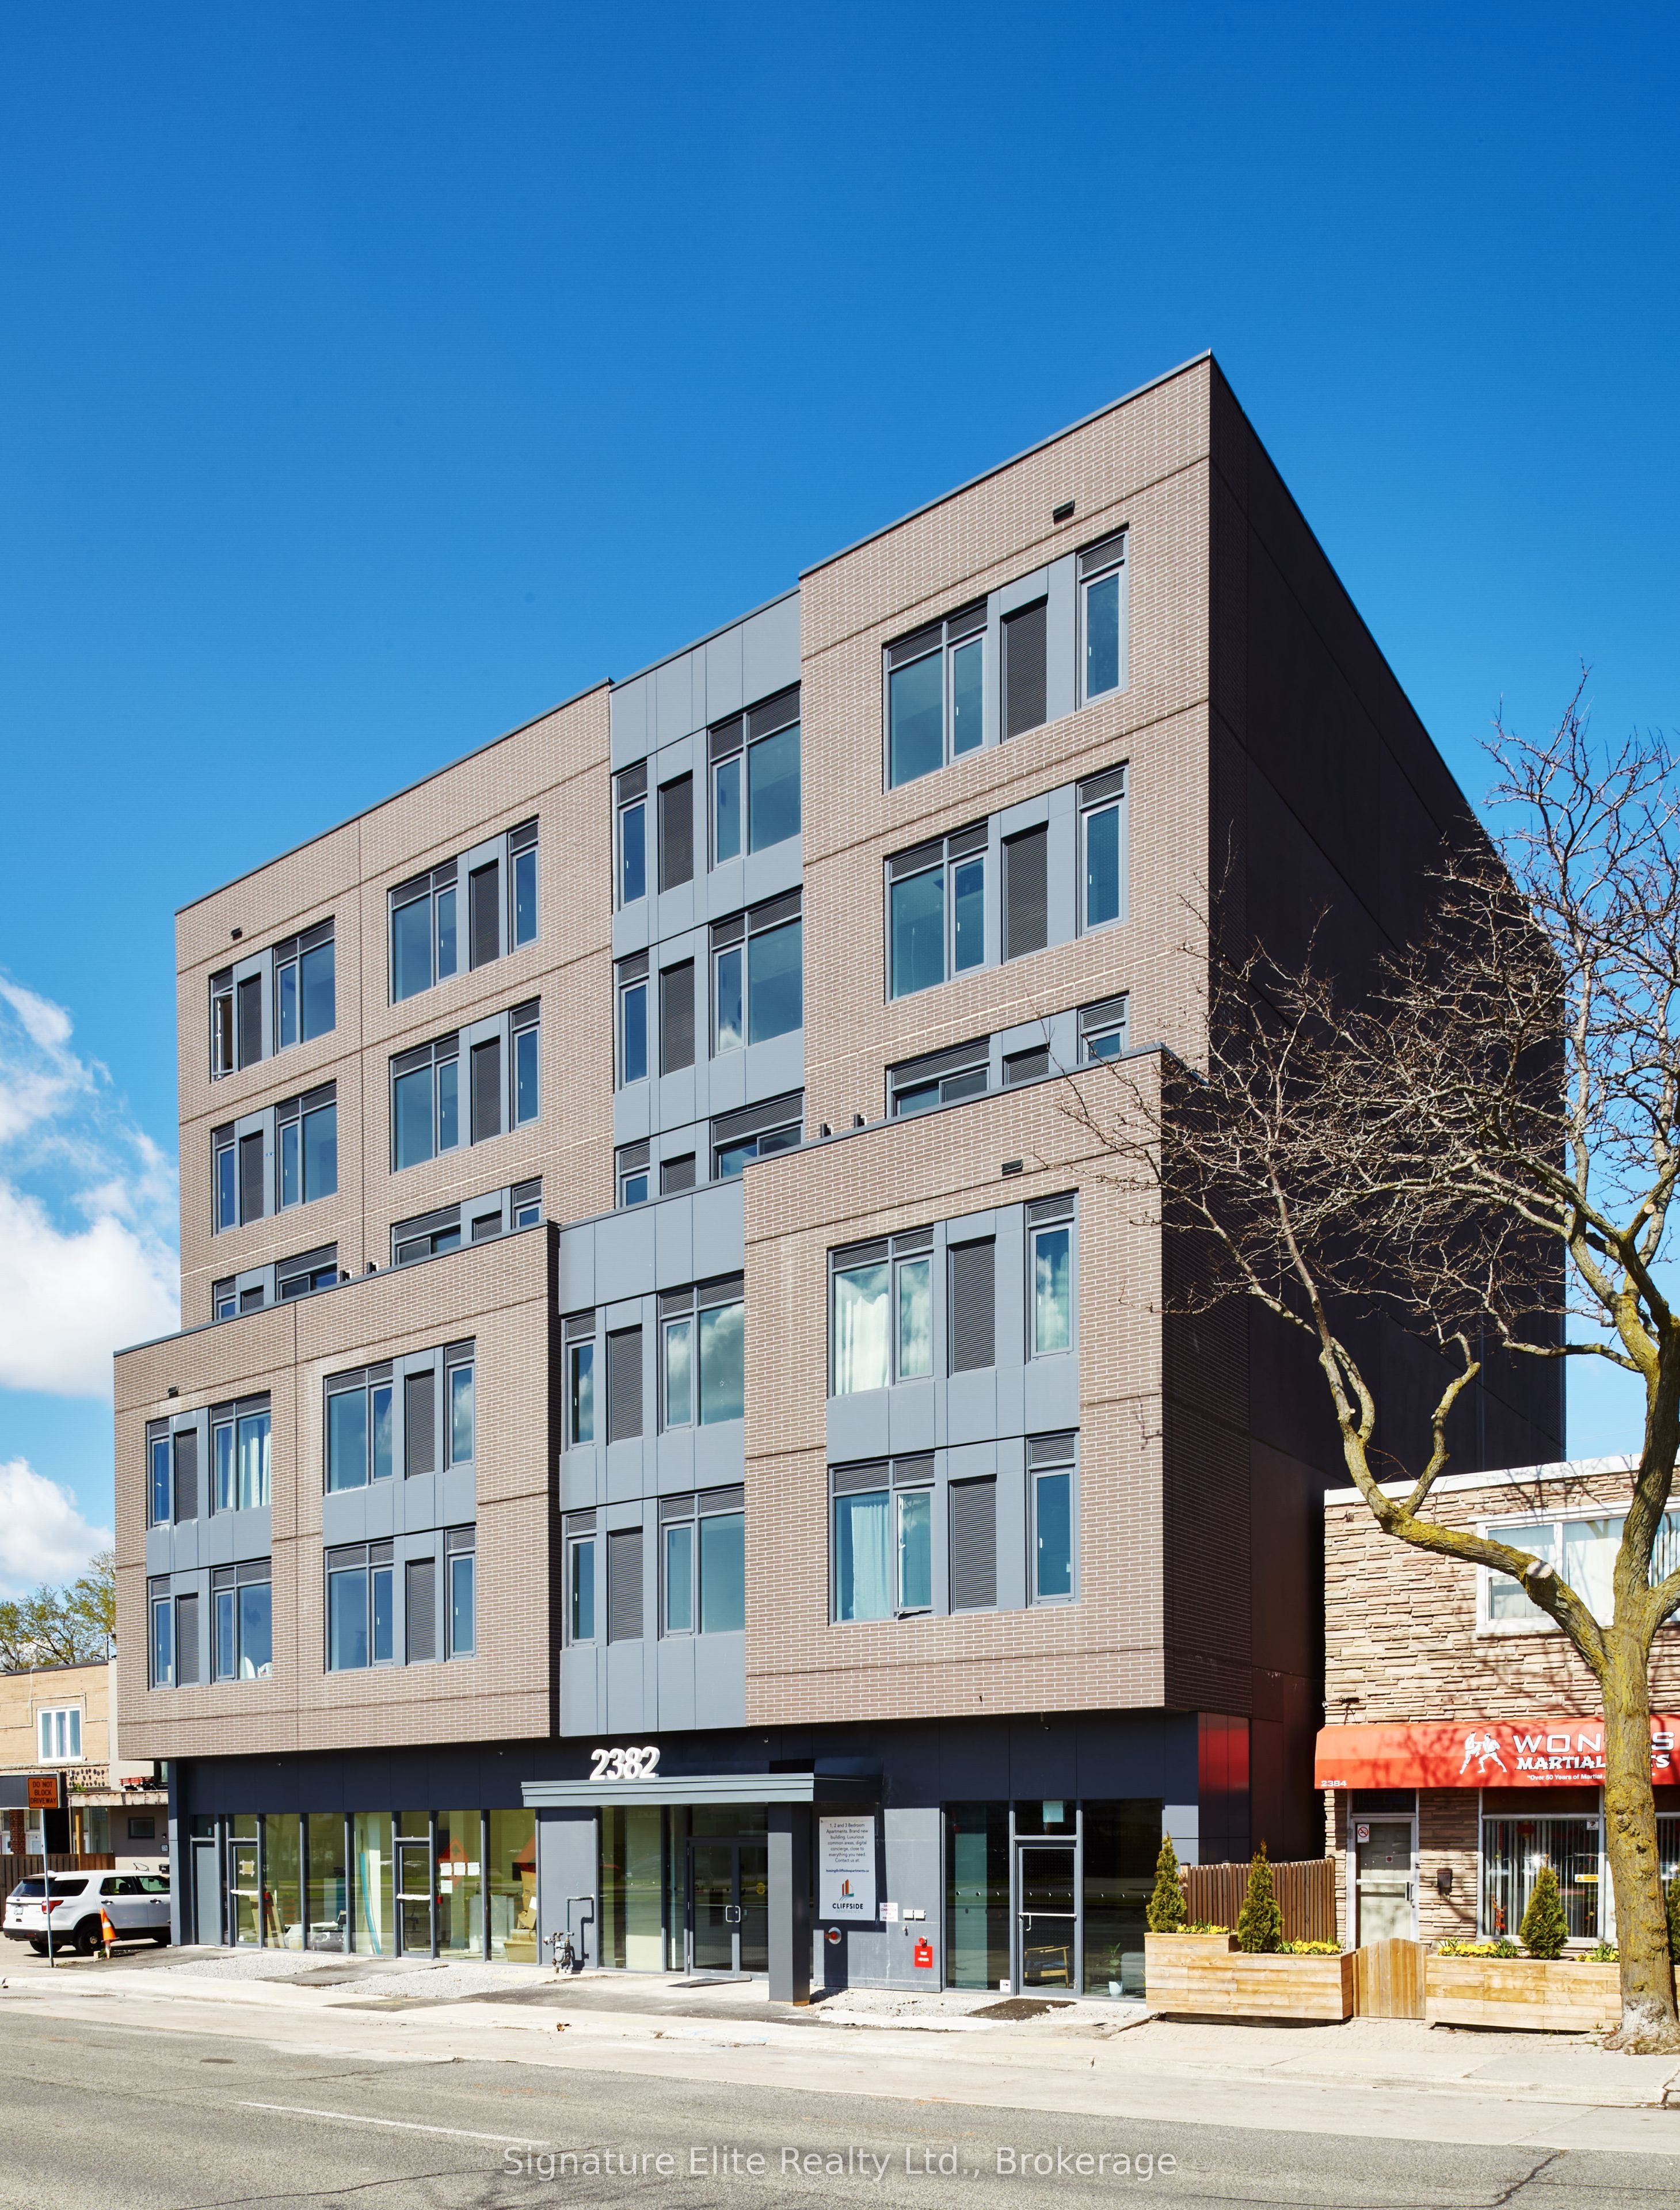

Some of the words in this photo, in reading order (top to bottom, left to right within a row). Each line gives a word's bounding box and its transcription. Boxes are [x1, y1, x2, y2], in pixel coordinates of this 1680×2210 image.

[1513, 1731, 1674, 1754] WONS
[589, 1746, 660, 1780] 2382
[1516, 1755, 1606, 1770] MARTIAL
